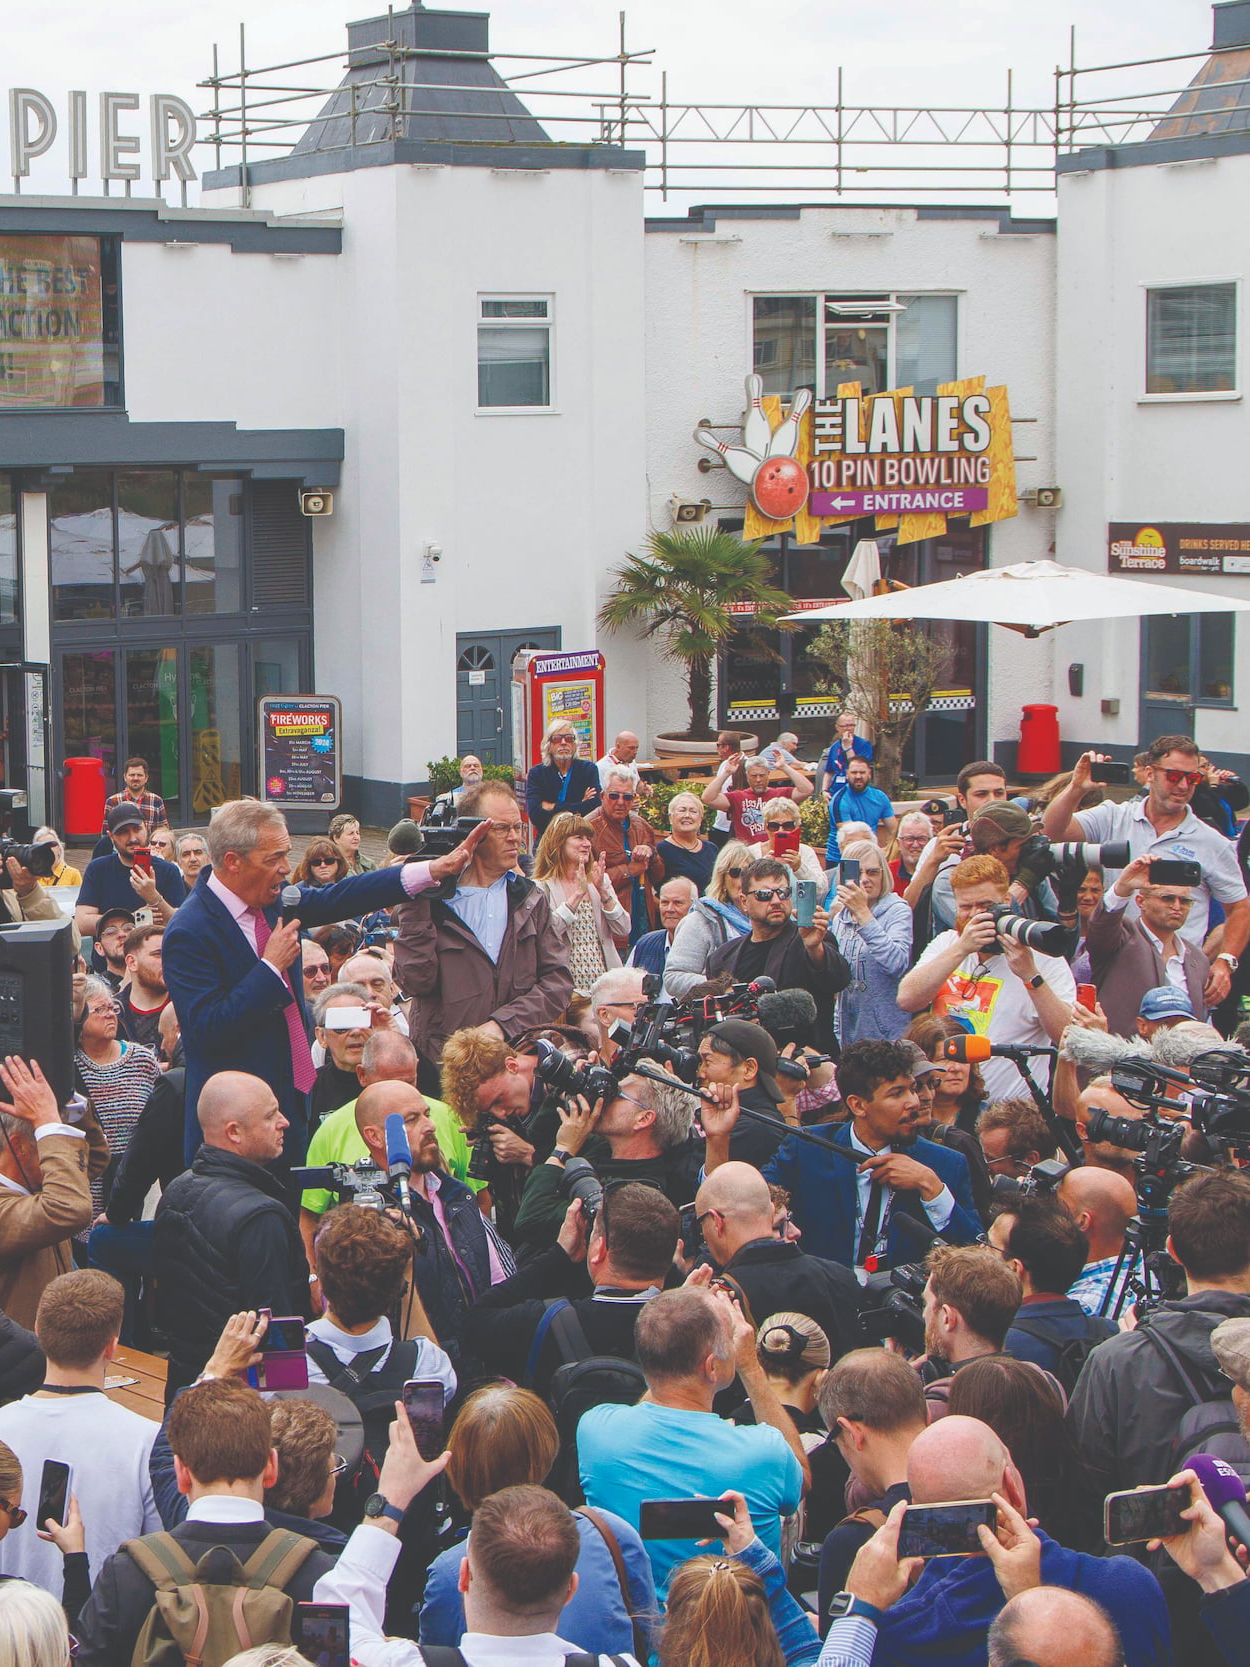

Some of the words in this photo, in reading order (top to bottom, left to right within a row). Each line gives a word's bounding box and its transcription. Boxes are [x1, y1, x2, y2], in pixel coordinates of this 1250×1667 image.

[9, 87, 198, 181] PIER
[36, 266, 92, 294] BEST
[814, 398, 843, 456] THE
[843, 394, 991, 454] LANES
[810, 460, 838, 488] 10
[841, 458, 880, 487] PIN
[883, 456, 991, 485] BOWLING
[862, 491, 964, 511] ENTRANCE
[1111, 542, 1166, 557] Sunshine
[1179, 538, 1208, 550] DRINKS
[1210, 538, 1240, 550] SERVED
[1119, 555, 1166, 569] Terrace
[536, 654, 600, 673] ENTERTAINMENT
[270, 713, 328, 725] FIREWORKS
[279, 726, 321, 735] Extravaganza!
